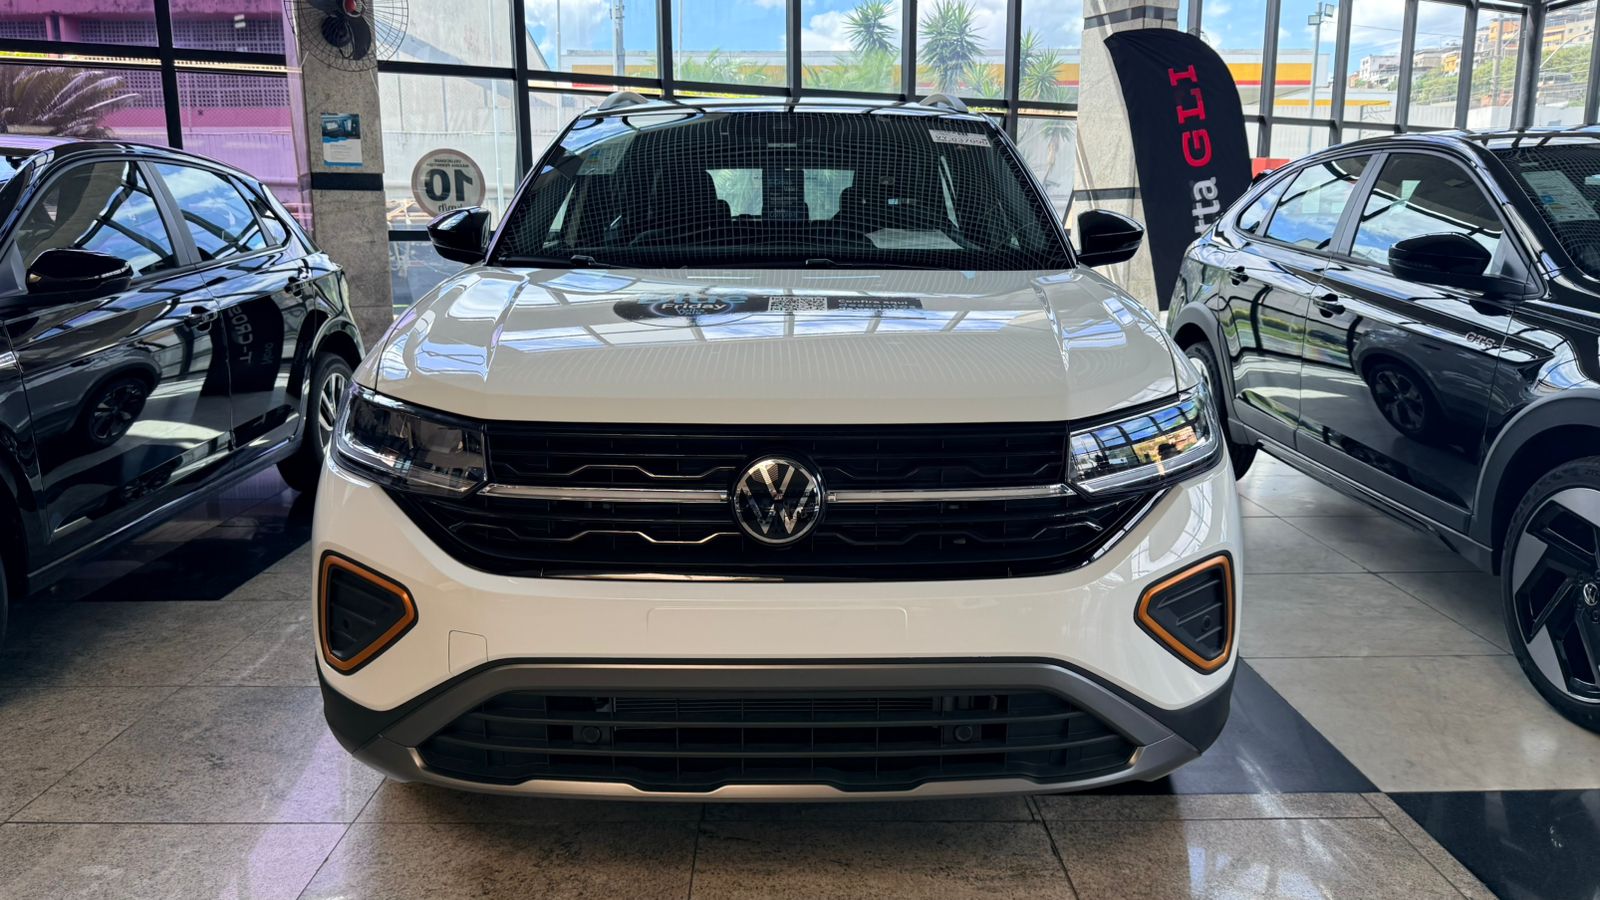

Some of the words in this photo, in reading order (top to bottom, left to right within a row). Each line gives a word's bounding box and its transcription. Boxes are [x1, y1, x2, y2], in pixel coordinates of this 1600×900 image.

[1168, 64, 1213, 168] GLI
[661, 302, 727, 311] Friday
[1465, 331, 1496, 349] GTS
